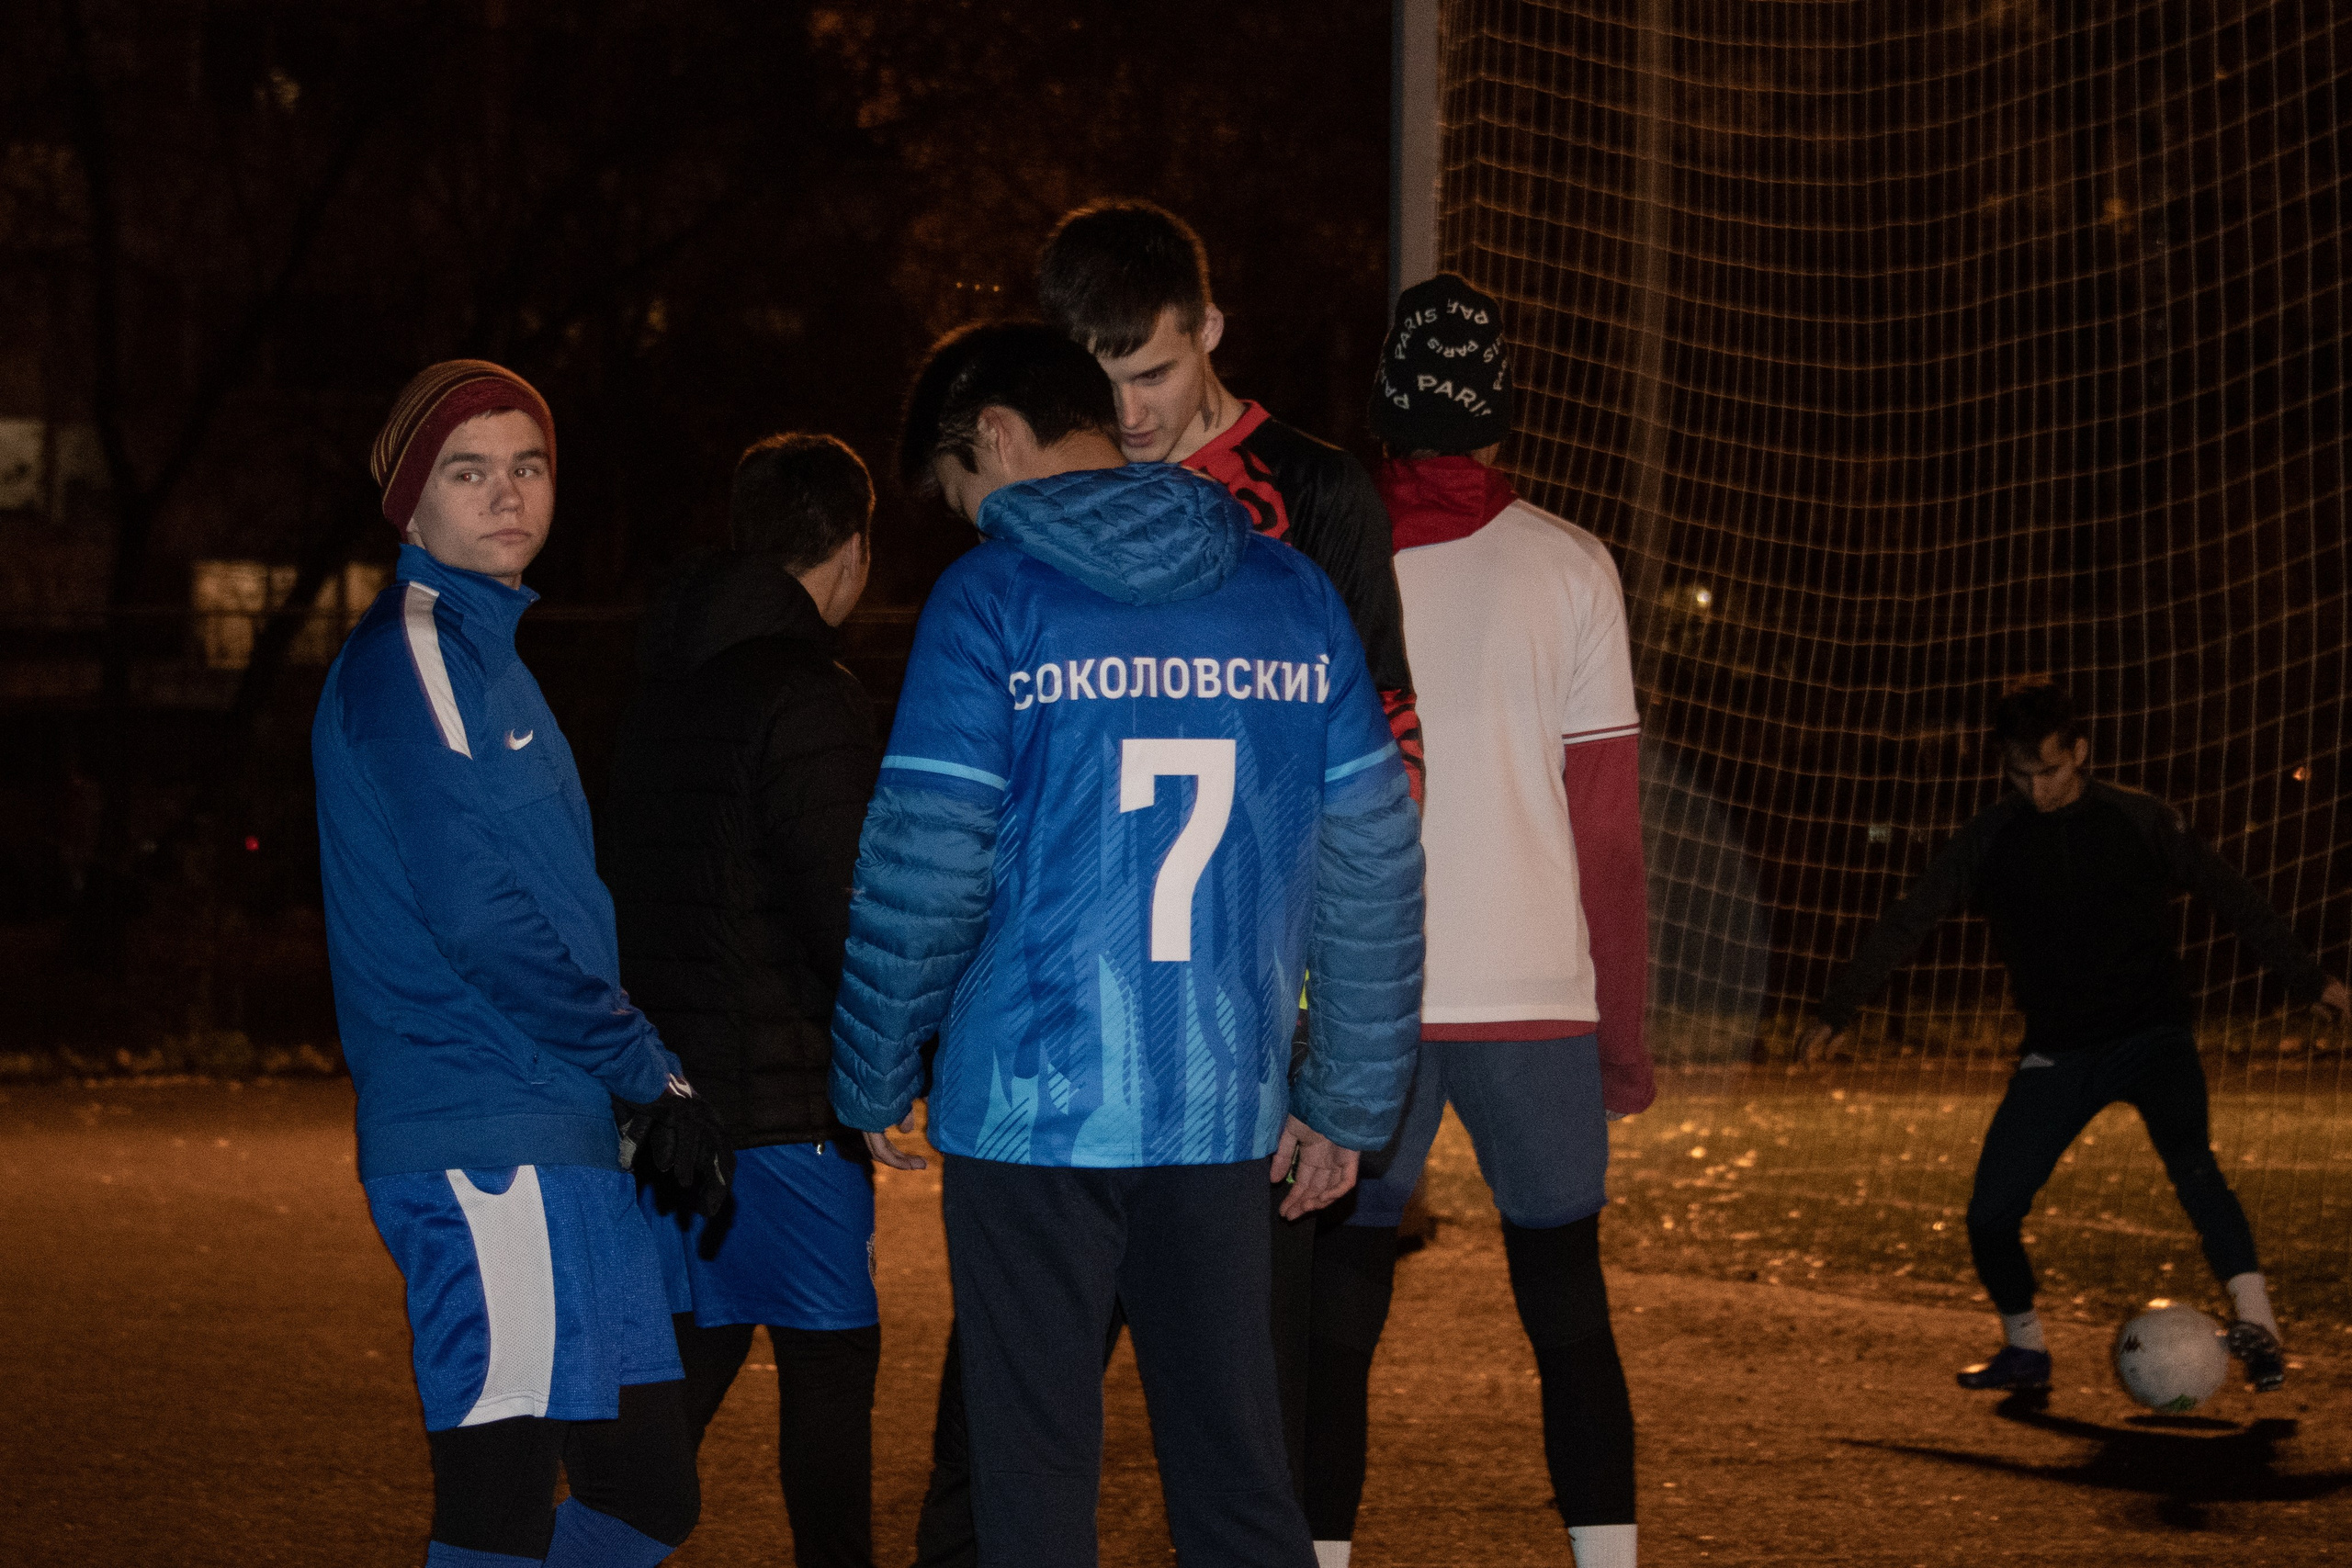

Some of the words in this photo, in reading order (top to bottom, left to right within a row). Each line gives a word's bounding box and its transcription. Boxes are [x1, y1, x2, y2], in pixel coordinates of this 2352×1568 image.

[1394, 308, 1438, 360] PARIS
[1427, 336, 1479, 358] PARIS
[1120, 739, 1237, 962] 7
